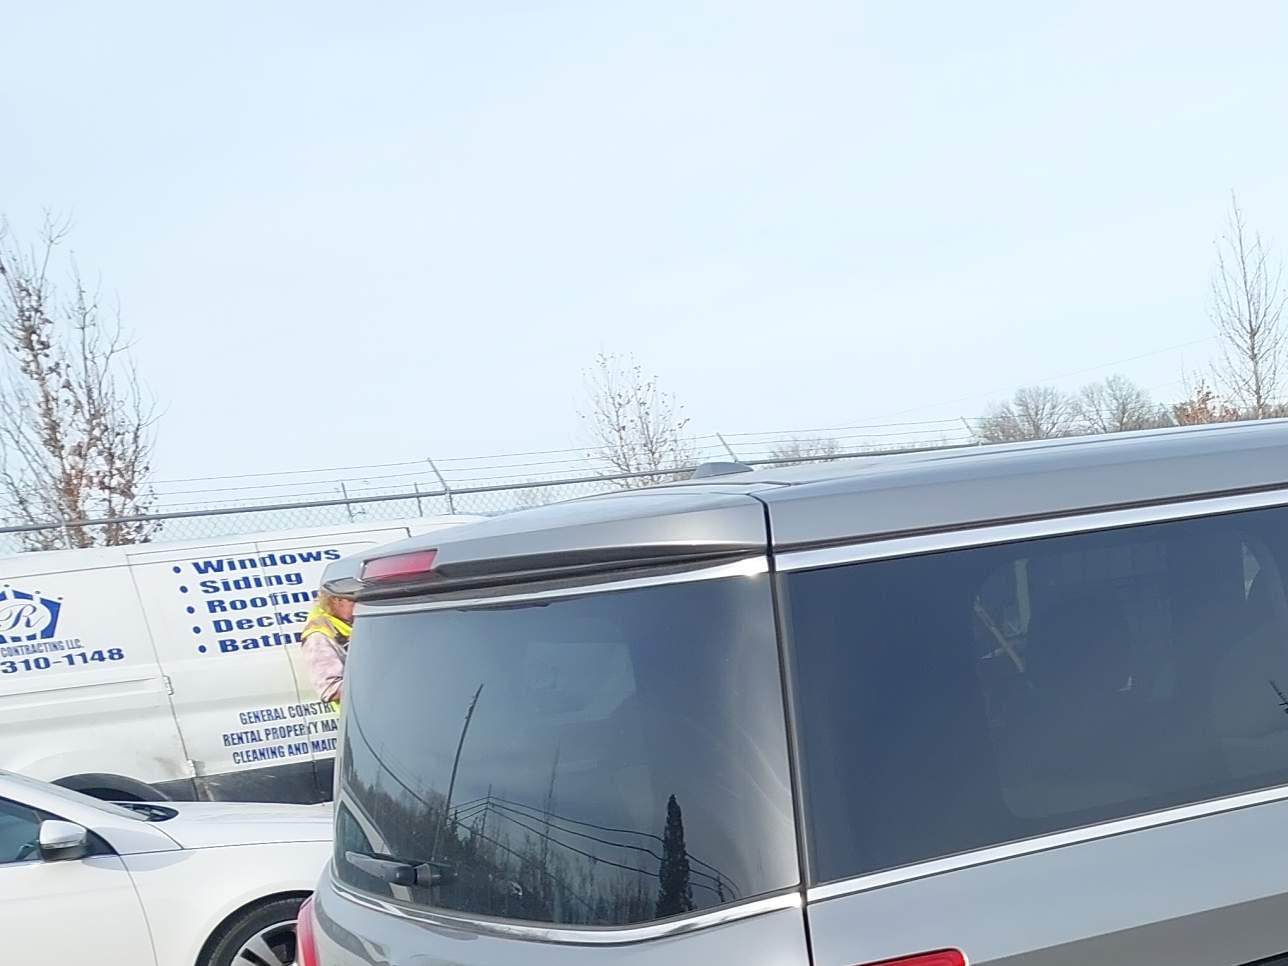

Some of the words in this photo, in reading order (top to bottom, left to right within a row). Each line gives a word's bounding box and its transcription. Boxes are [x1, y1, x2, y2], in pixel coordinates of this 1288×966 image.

[192, 549, 341, 575] Windows
[200, 572, 303, 593] Siding
[213, 611, 309, 634] Decks
[1, 641, 65, 657] CONTRACTING
[239, 707, 287, 725] GENERAL
[222, 730, 263, 747] RENTAL
[264, 721, 318, 740] PROPERTY
[321, 718, 340, 732] MA
[232, 745, 286, 764] CLEANING
[287, 742, 309, 757] AND
